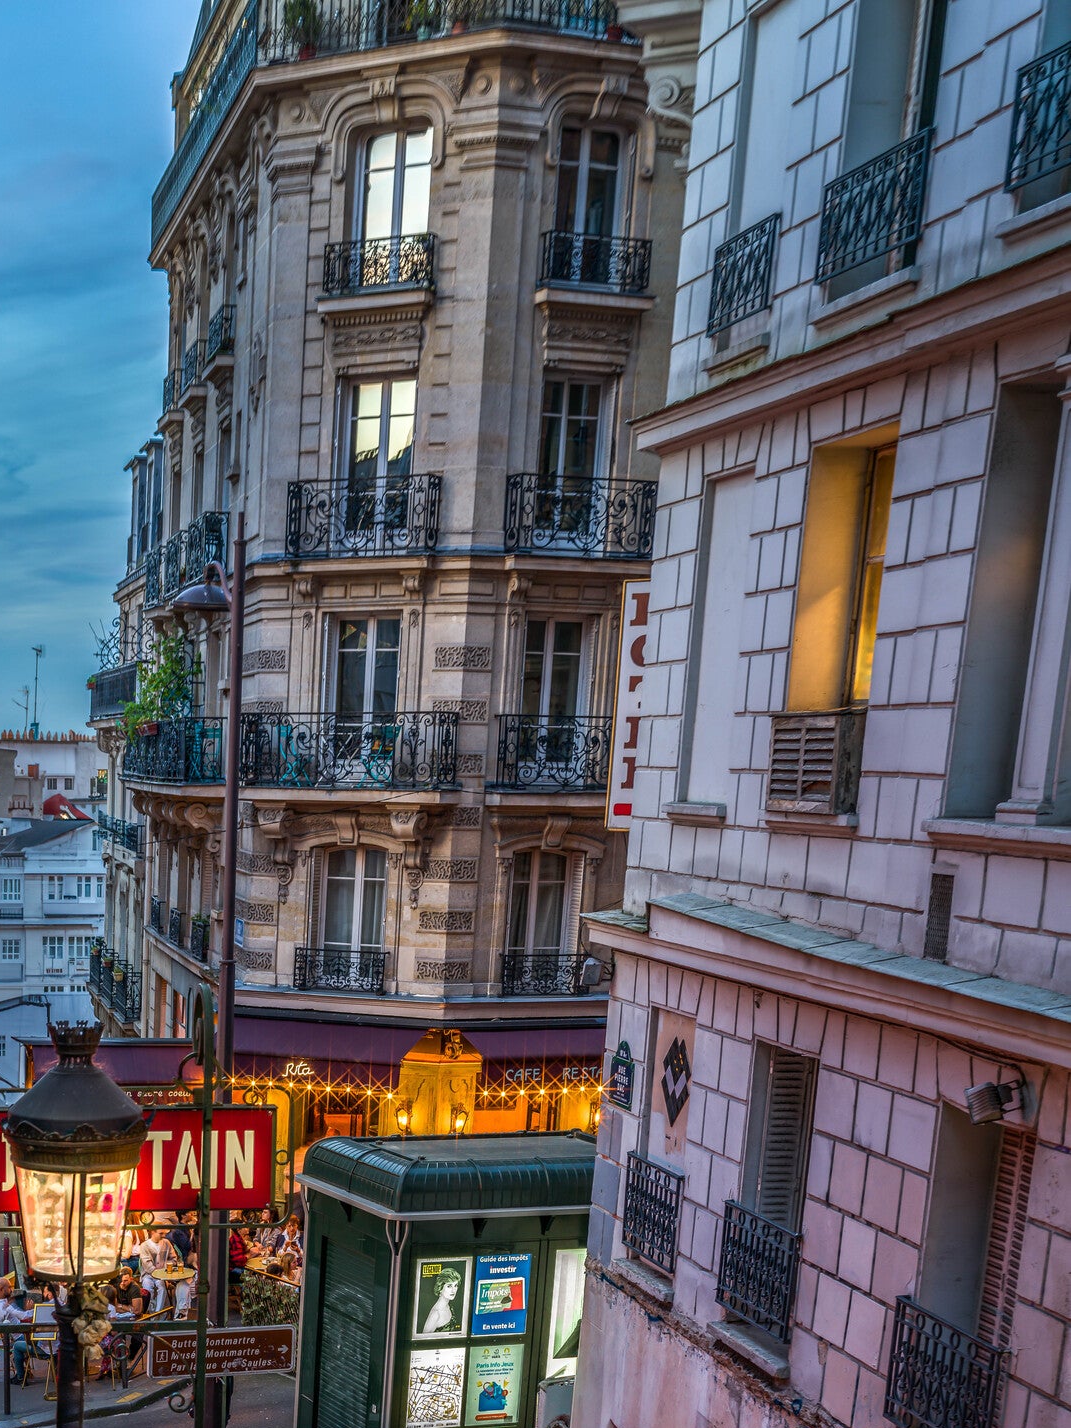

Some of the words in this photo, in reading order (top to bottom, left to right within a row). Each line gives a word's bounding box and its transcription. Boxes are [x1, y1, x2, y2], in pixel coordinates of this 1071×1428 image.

[282, 1061, 314, 1077] Rita
[490, 1265, 517, 1274] investir
[481, 1287, 509, 1299] Impôts
[171, 1350, 196, 1360] Musé
[205, 1348, 260, 1358] Montmartre
[240, 1358, 272, 1368] Saules
